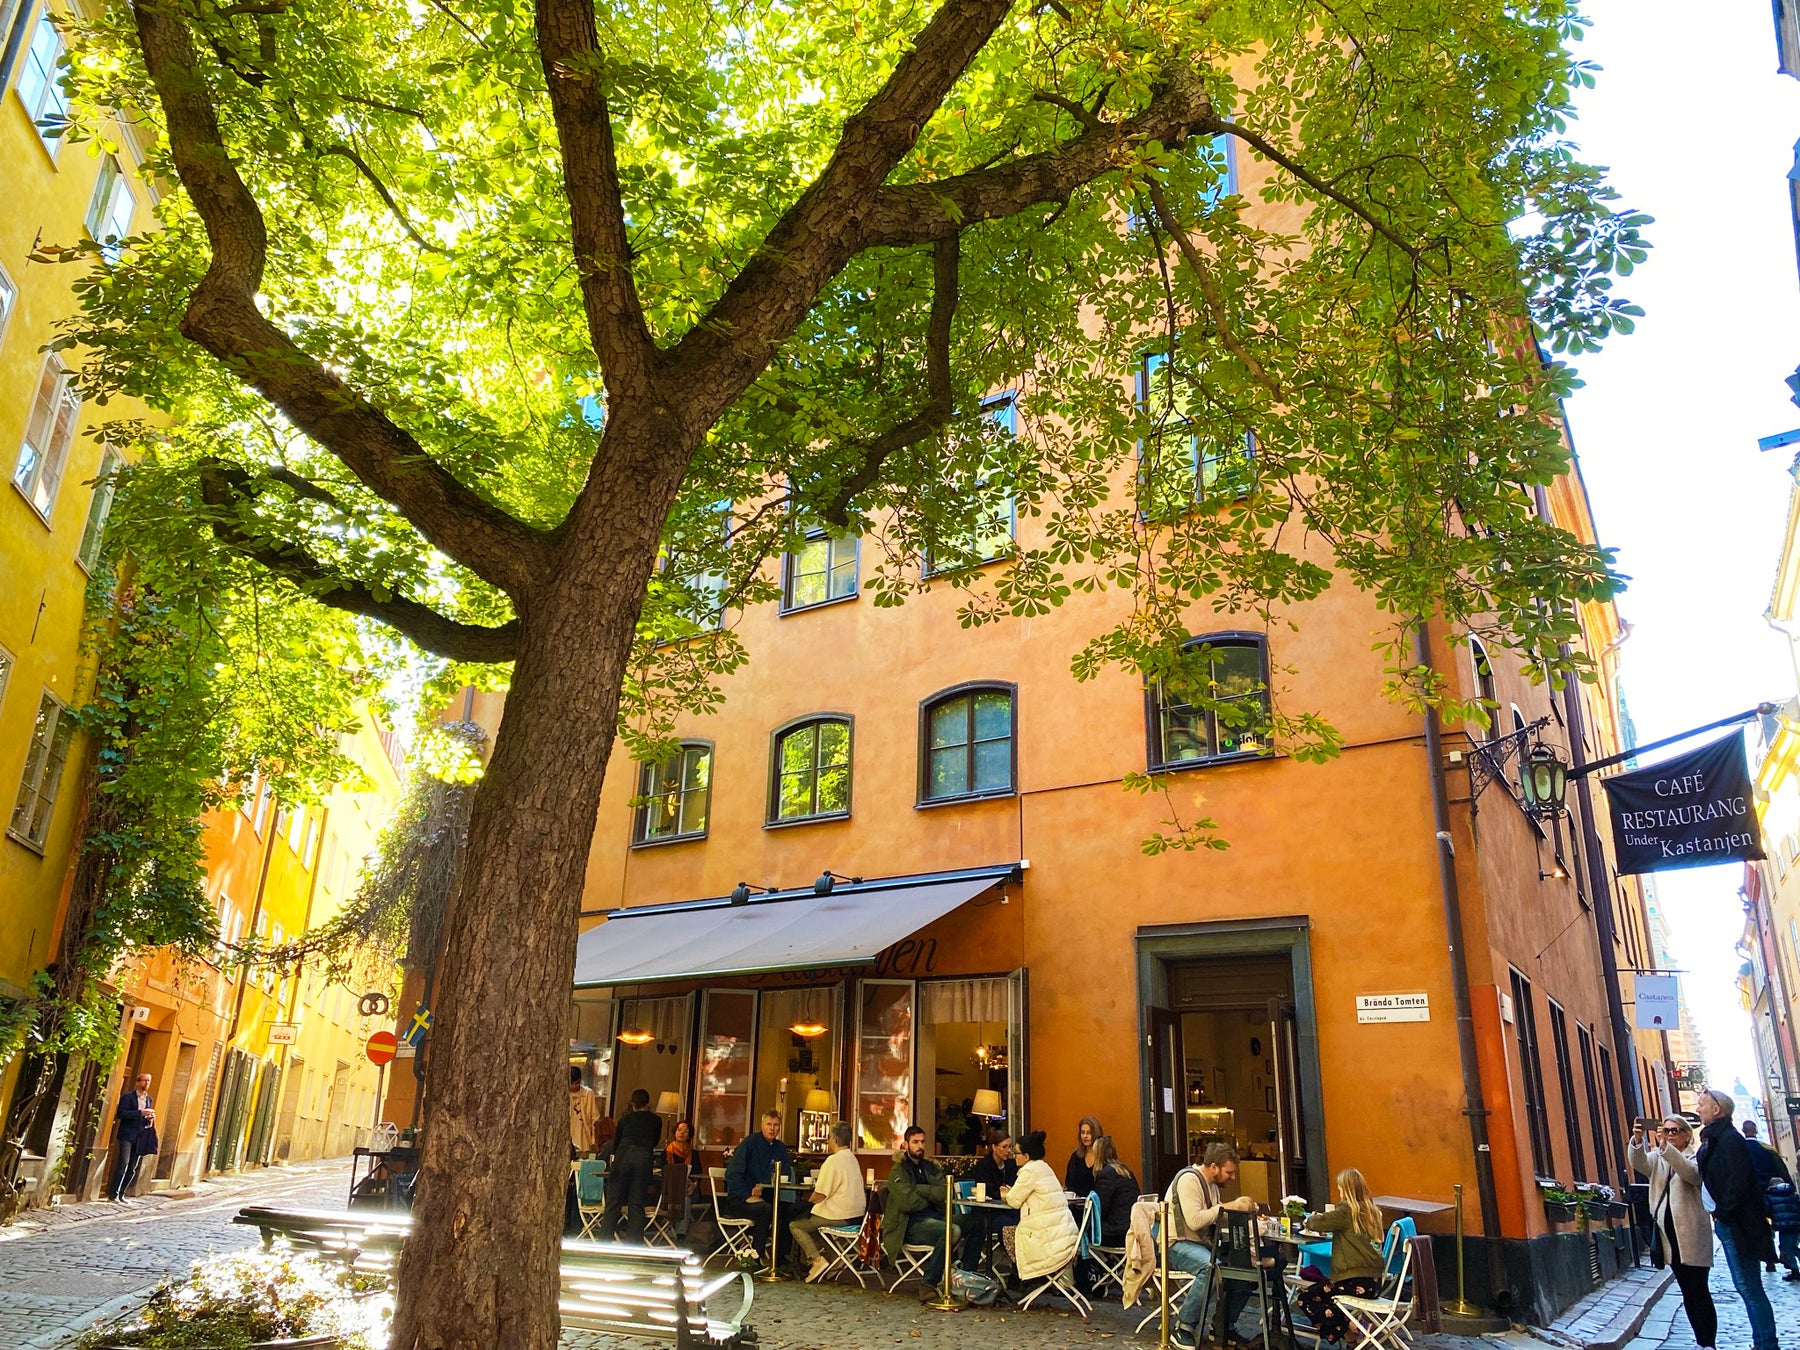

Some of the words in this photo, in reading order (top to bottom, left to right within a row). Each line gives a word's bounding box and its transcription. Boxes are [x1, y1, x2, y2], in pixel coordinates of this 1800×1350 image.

[1654, 769, 1705, 797] CAFÉ
[1621, 797, 1747, 830] RESTAURANG
[1625, 834, 1659, 846] Under
[1660, 832, 1753, 858] Kastanjen
[1364, 997, 1392, 1007] Brända
[1395, 997, 1425, 1006] Tomten
[1639, 992, 1674, 1001] Castanea
